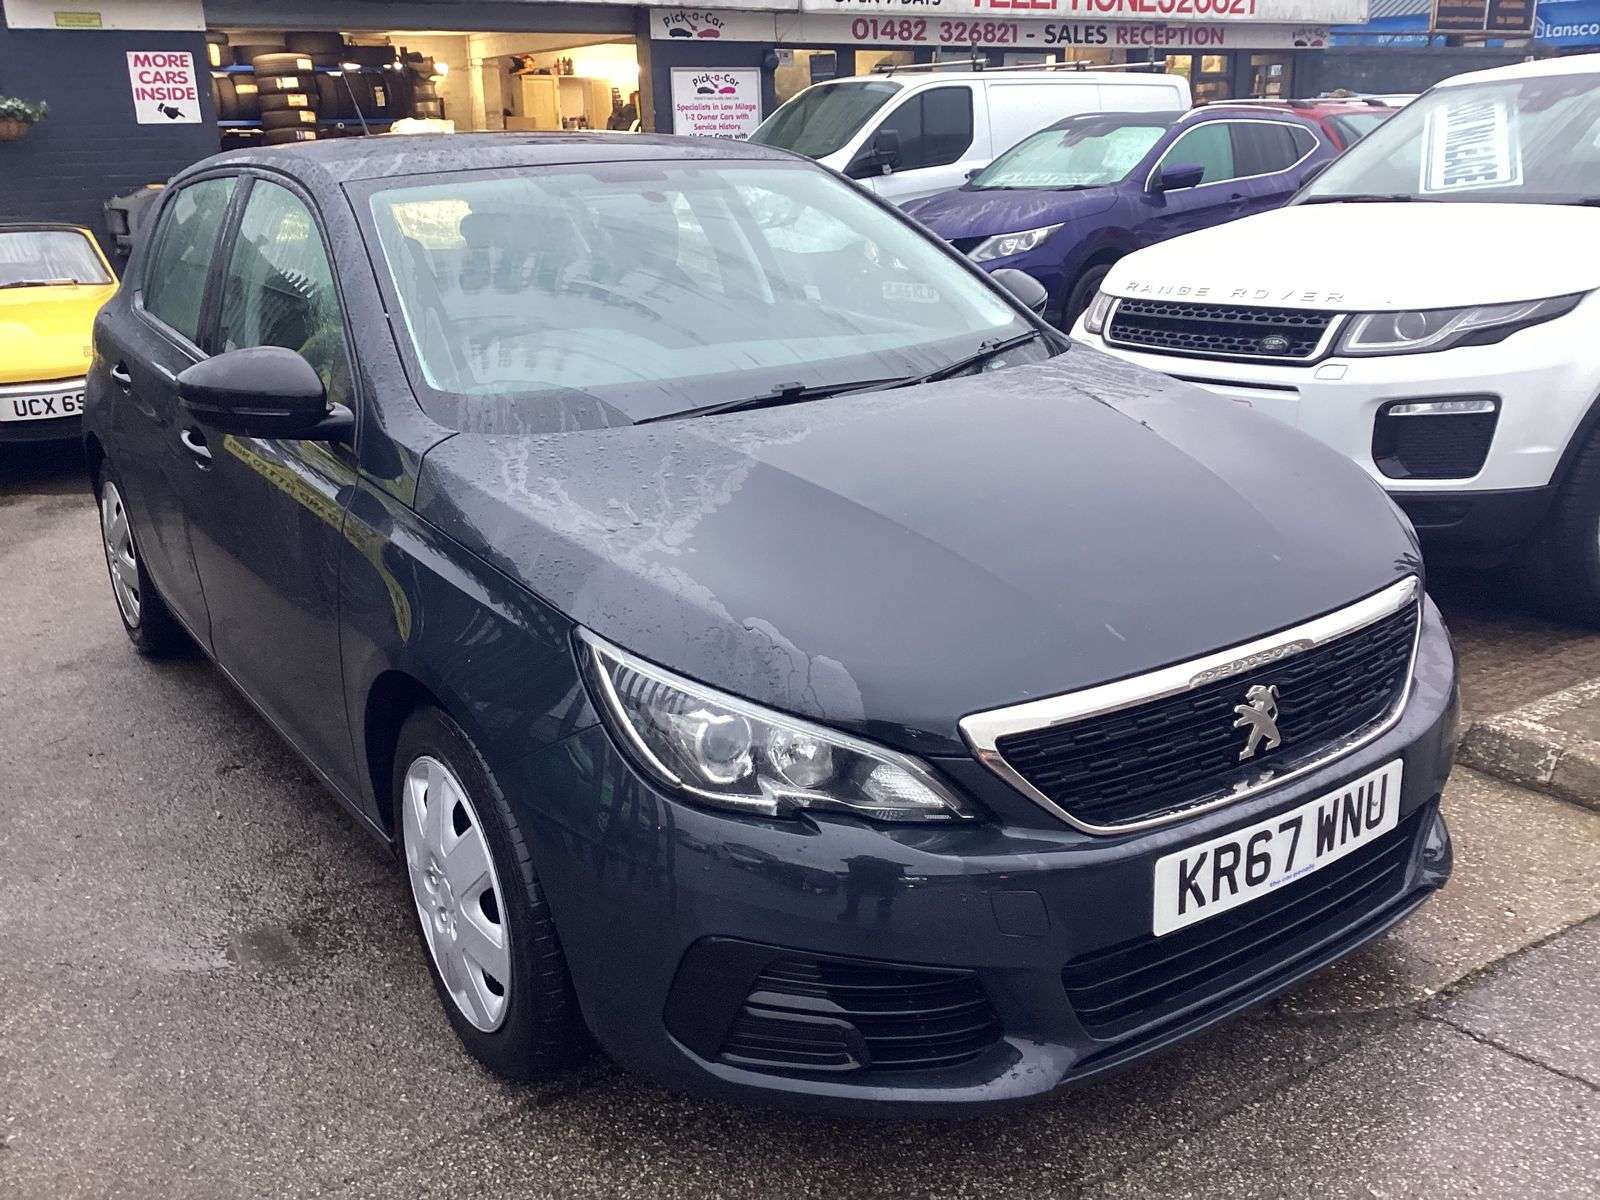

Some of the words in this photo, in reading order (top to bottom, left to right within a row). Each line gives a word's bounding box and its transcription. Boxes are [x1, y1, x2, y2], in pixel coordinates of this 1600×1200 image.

[663, 11, 725, 28] Pick-a-Car
[852, 18, 927, 41] 01482
[939, 21, 1017, 43] 326821
[1044, 24, 1107, 44] SALES
[1116, 25, 1224, 45] RECEPTION
[1545, 23, 1600, 38] Lansco
[134, 54, 189, 67] MORE
[139, 71, 188, 84] CARS
[692, 73, 740, 87] Pick-a-Car
[135, 87, 196, 101] INSIDE
[676, 103, 711, 112] Specialists
[735, 103, 757, 112] Milage
[694, 123, 717, 131] Service
[1125, 281, 1211, 297] RANGE
[1229, 287, 1345, 303] ROVER
[13, 398, 57, 416] UCX
[1177, 815, 1303, 916] KR67
[1315, 773, 1389, 859] WNU
